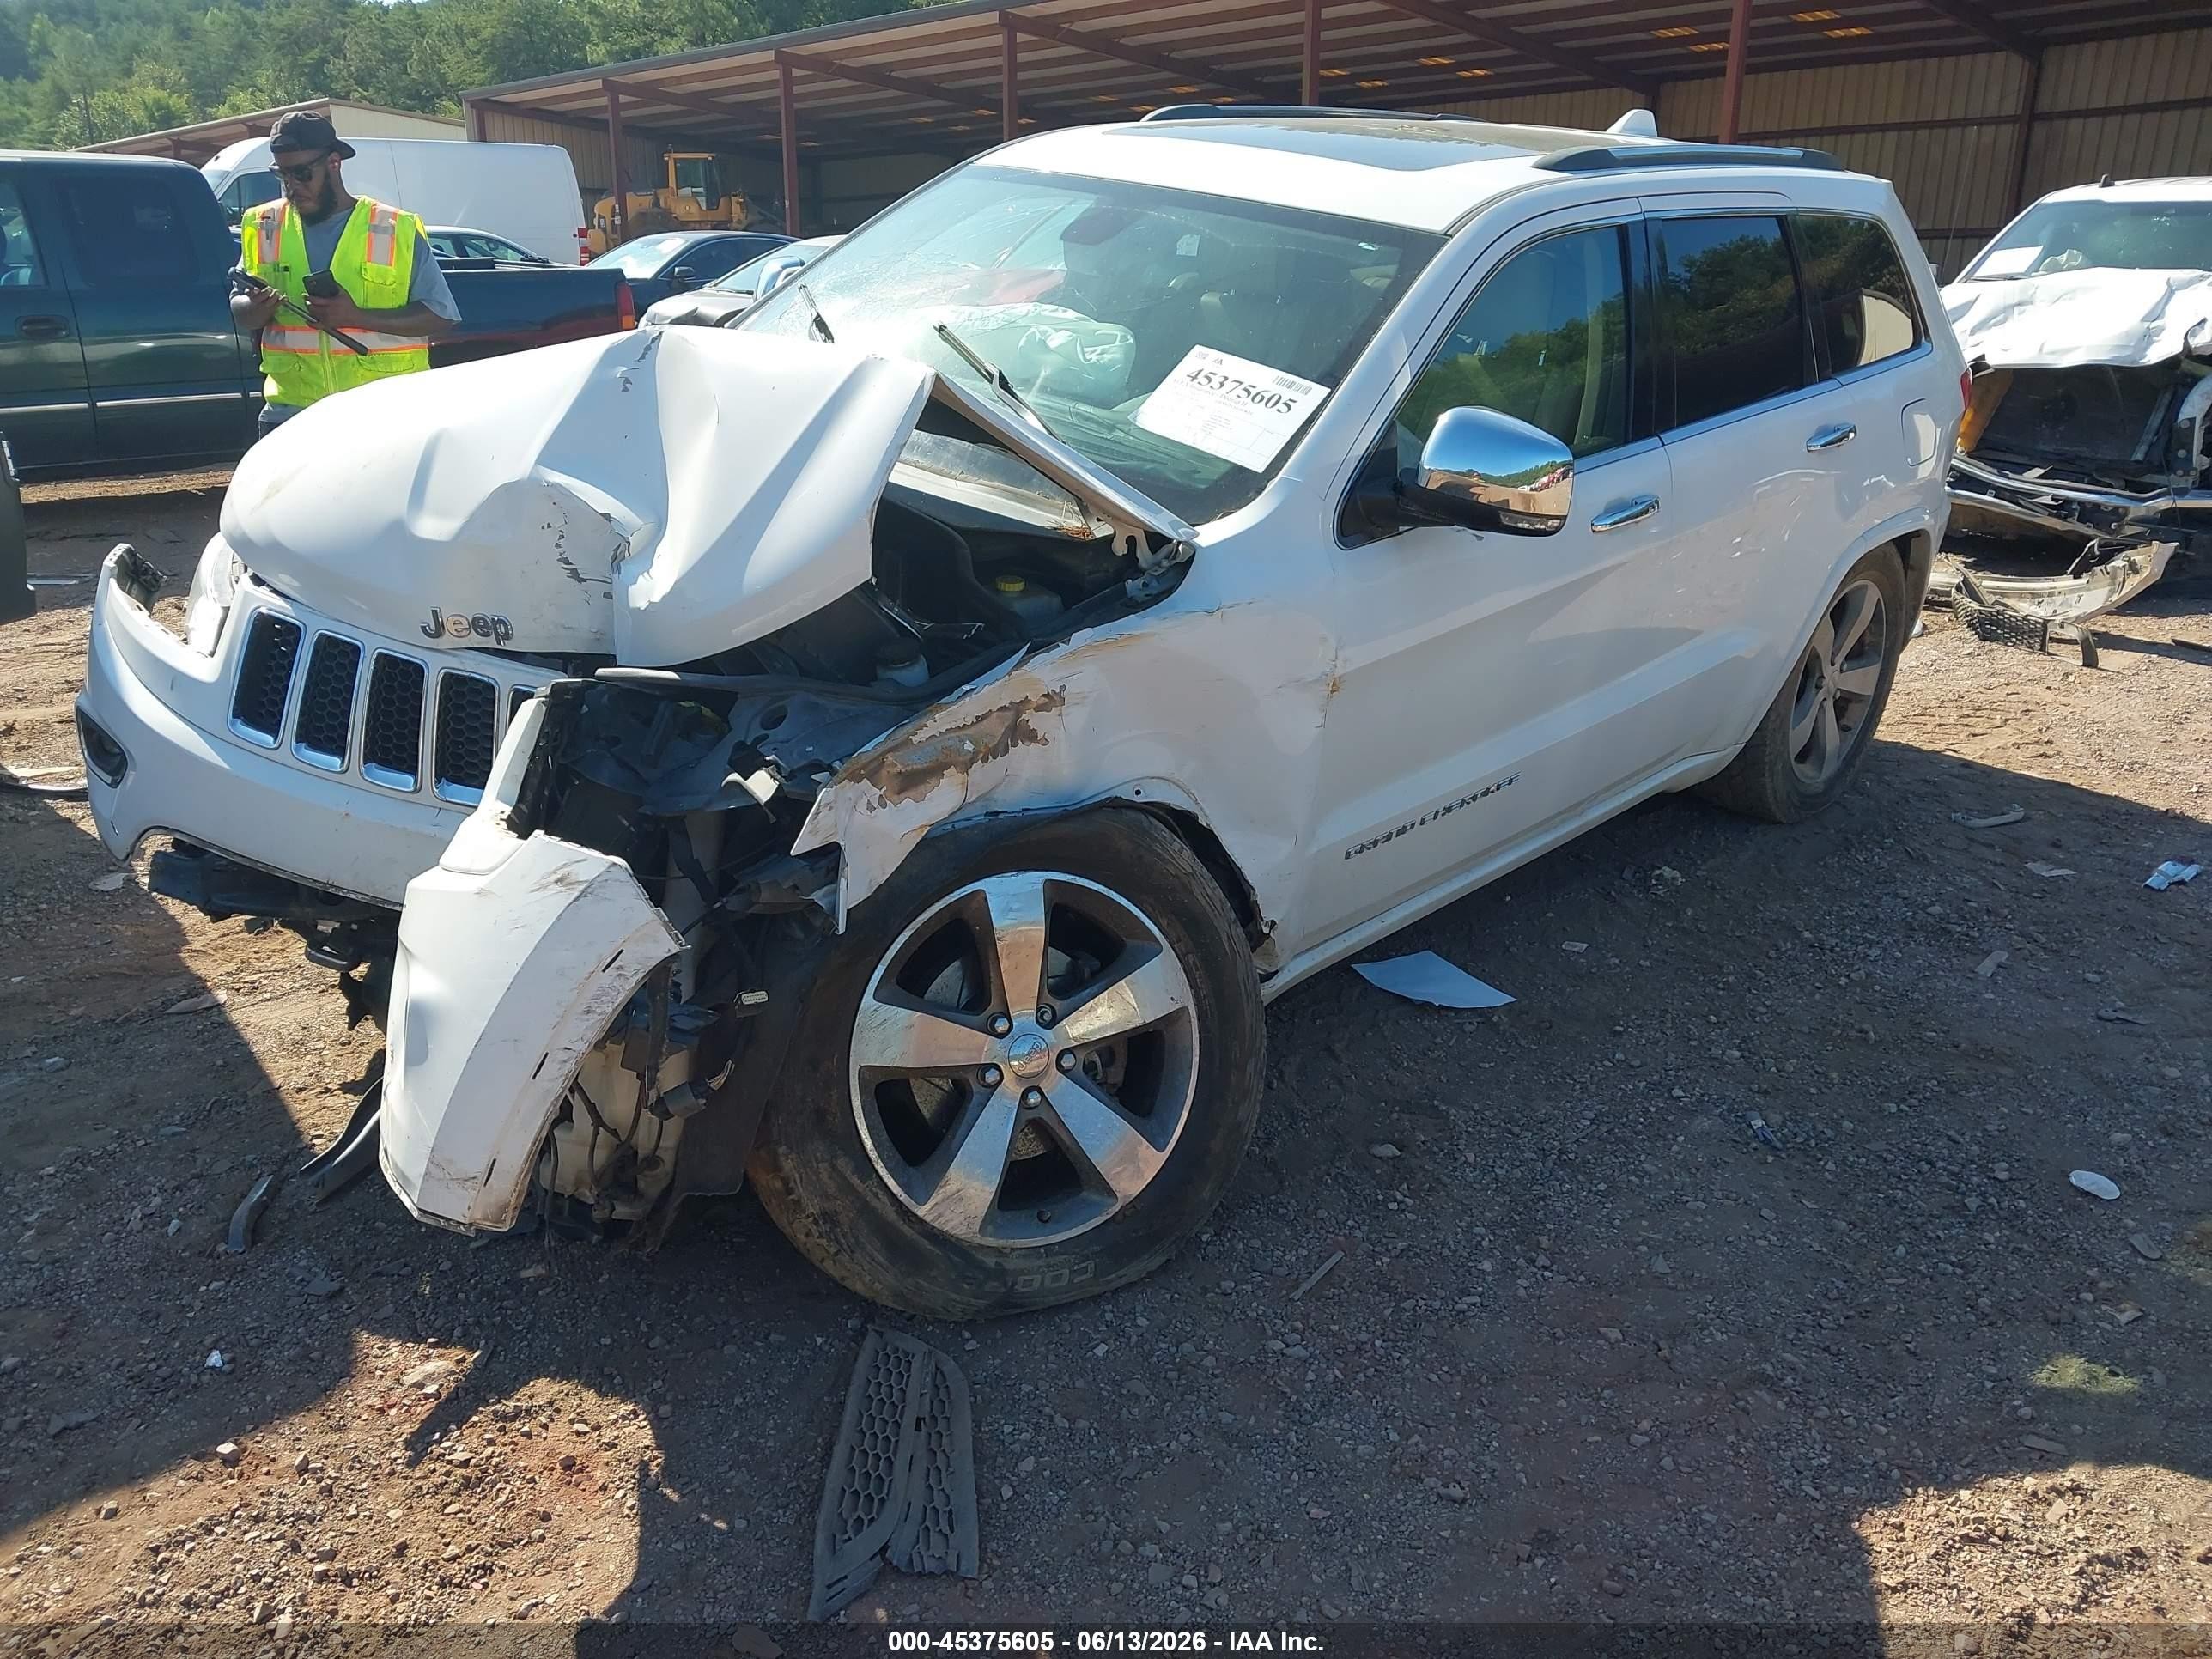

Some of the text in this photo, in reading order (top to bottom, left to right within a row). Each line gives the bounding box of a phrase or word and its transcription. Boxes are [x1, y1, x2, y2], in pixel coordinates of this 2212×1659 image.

[1186, 368, 1298, 414] 45375605
[419, 605, 514, 647] Jeep
[1344, 770, 1524, 860] GRAND CHEROKEE
[1017, 1041, 1042, 1072] Jeep
